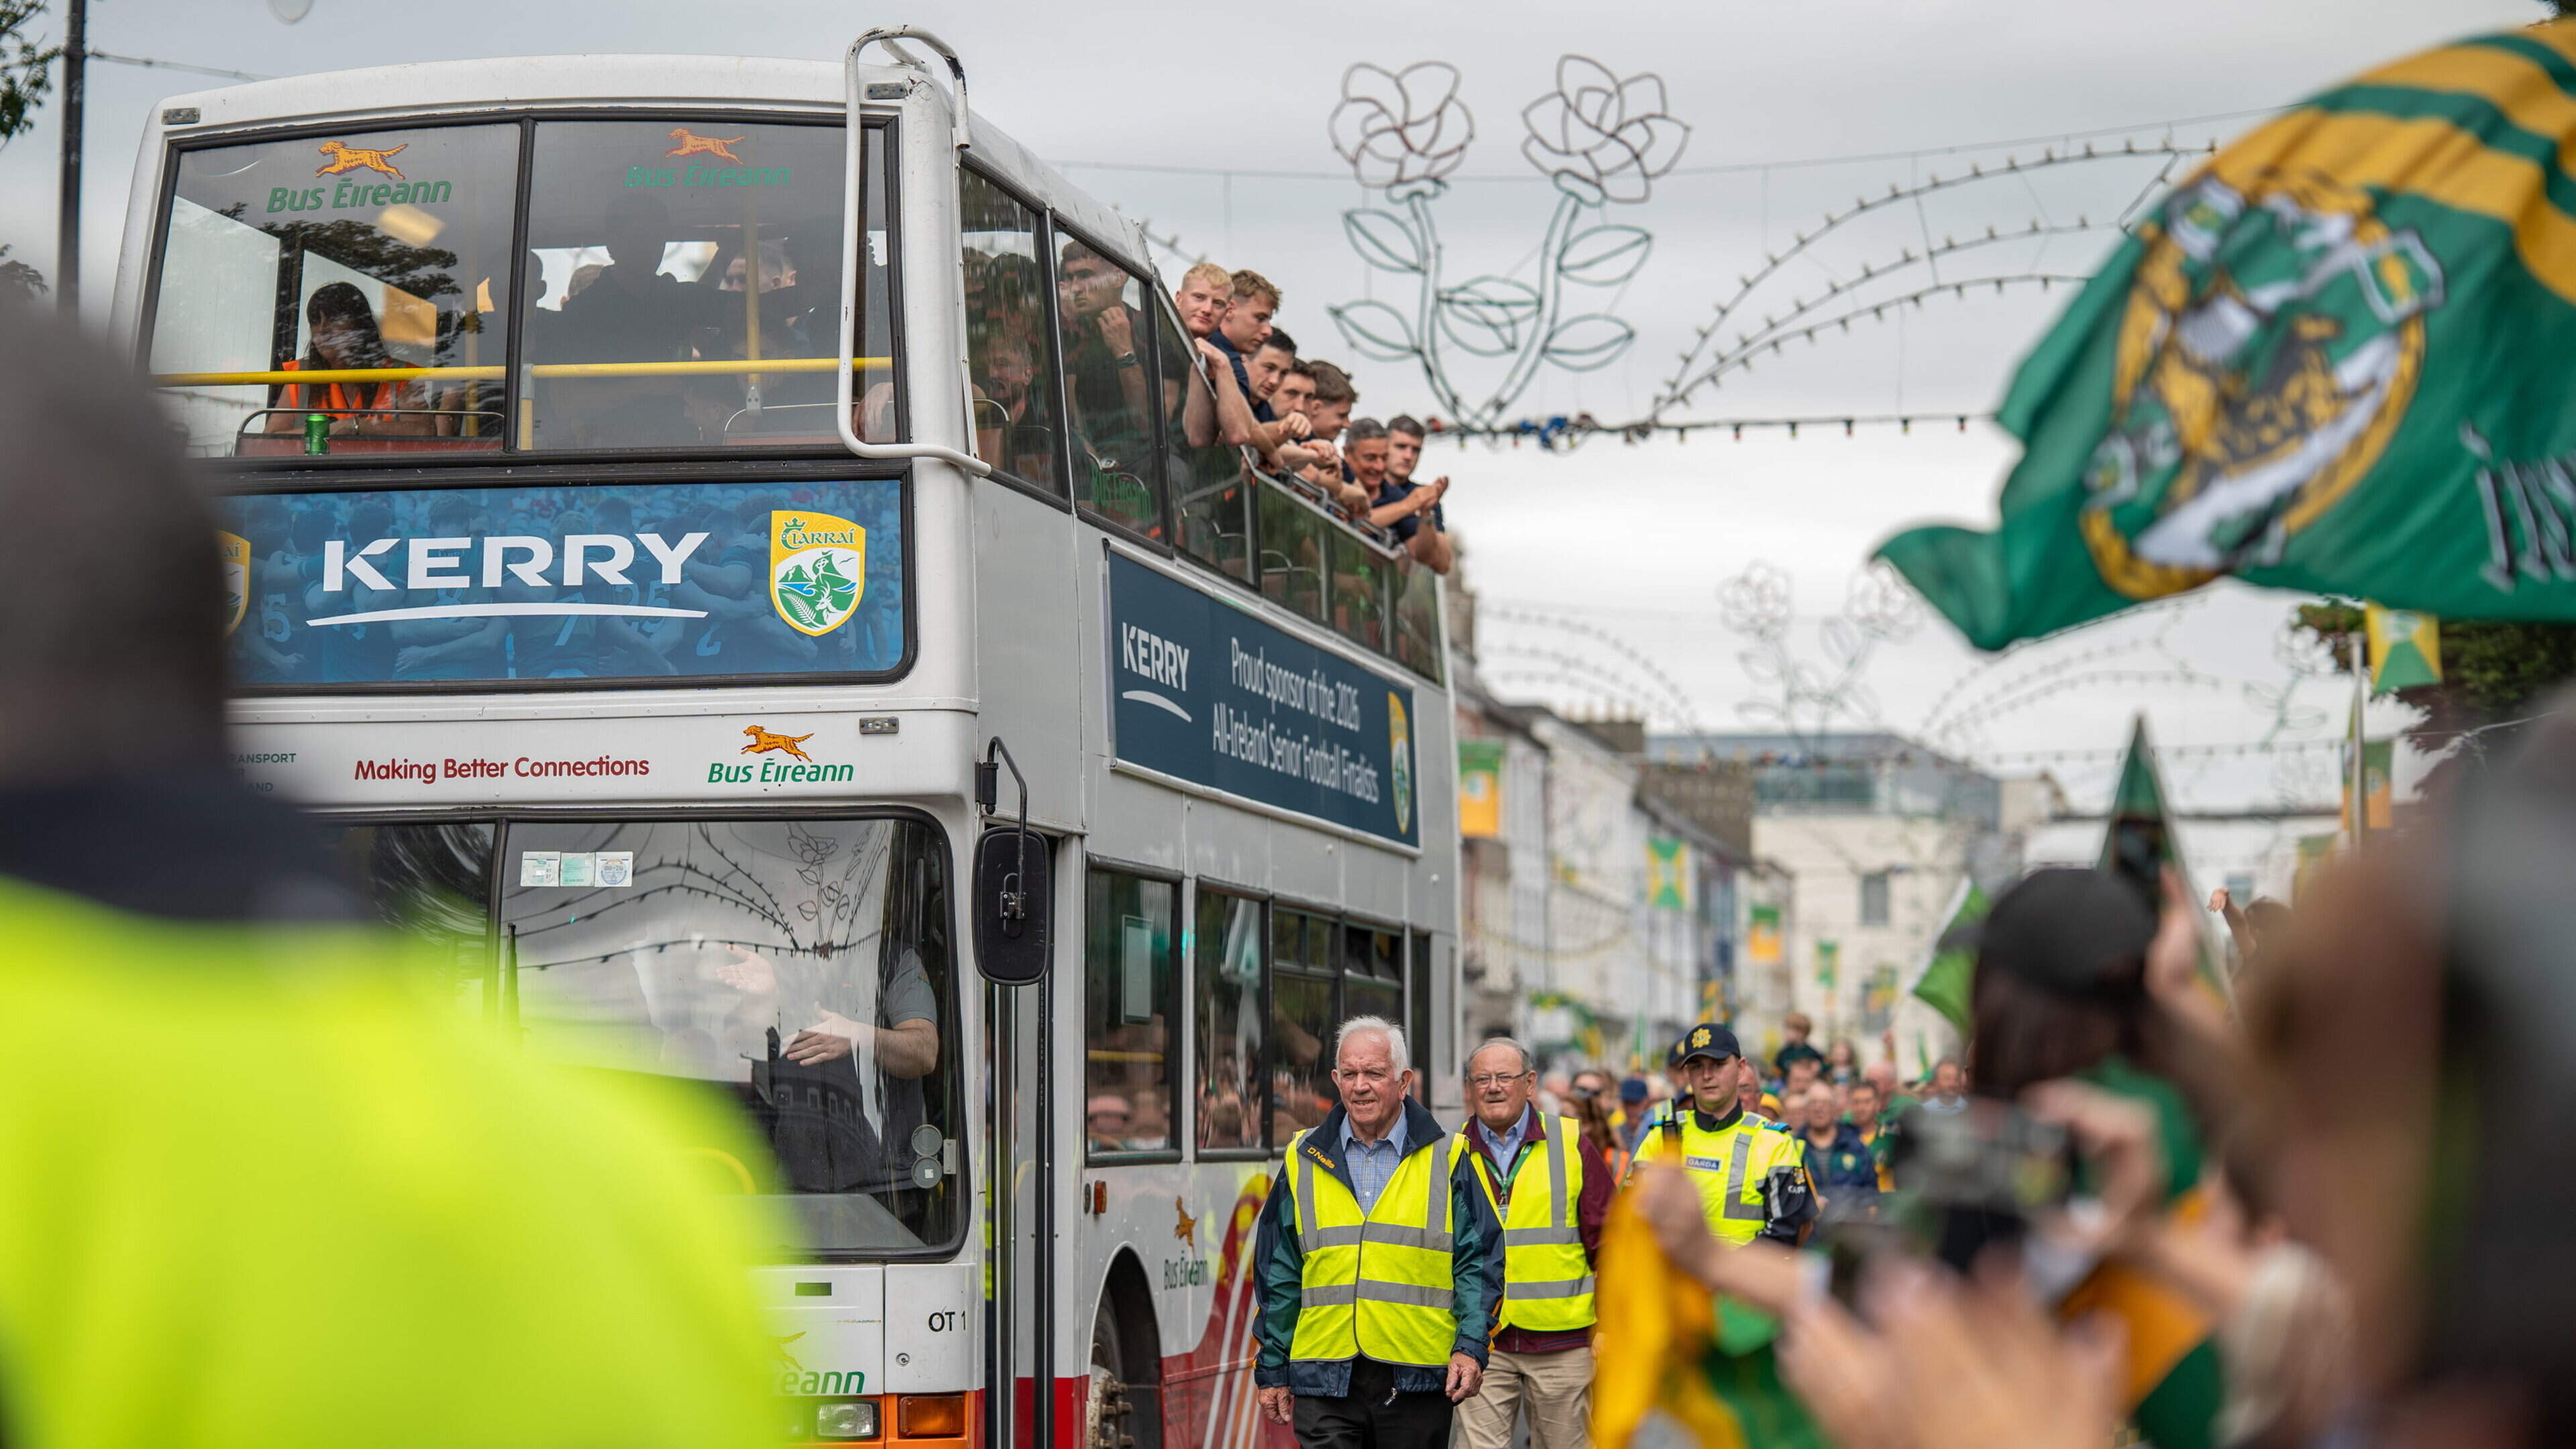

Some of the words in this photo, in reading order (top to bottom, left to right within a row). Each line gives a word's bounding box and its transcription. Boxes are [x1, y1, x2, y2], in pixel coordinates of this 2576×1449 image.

[624, 165, 676, 188] Bus
[266, 186, 325, 213] Bus
[323, 532, 712, 592] KERRY
[1122, 622, 1190, 692] KERRY
[1231, 637, 1265, 696] Proud
[1265, 661, 1307, 714] sponsor
[1307, 668, 1319, 716] of
[1318, 672, 1336, 724] the
[1212, 702, 1269, 768] All-Ireland
[1269, 722, 1302, 777] Senior
[1302, 734, 1341, 790] Football
[1341, 749, 1379, 804] Finalists
[354, 758, 437, 785] Making
[444, 758, 508, 779] Better
[514, 755, 650, 778] Connections
[707, 762, 754, 784] Bus
[1164, 1258, 1178, 1291] Bus
[928, 1311, 956, 1332] OT
